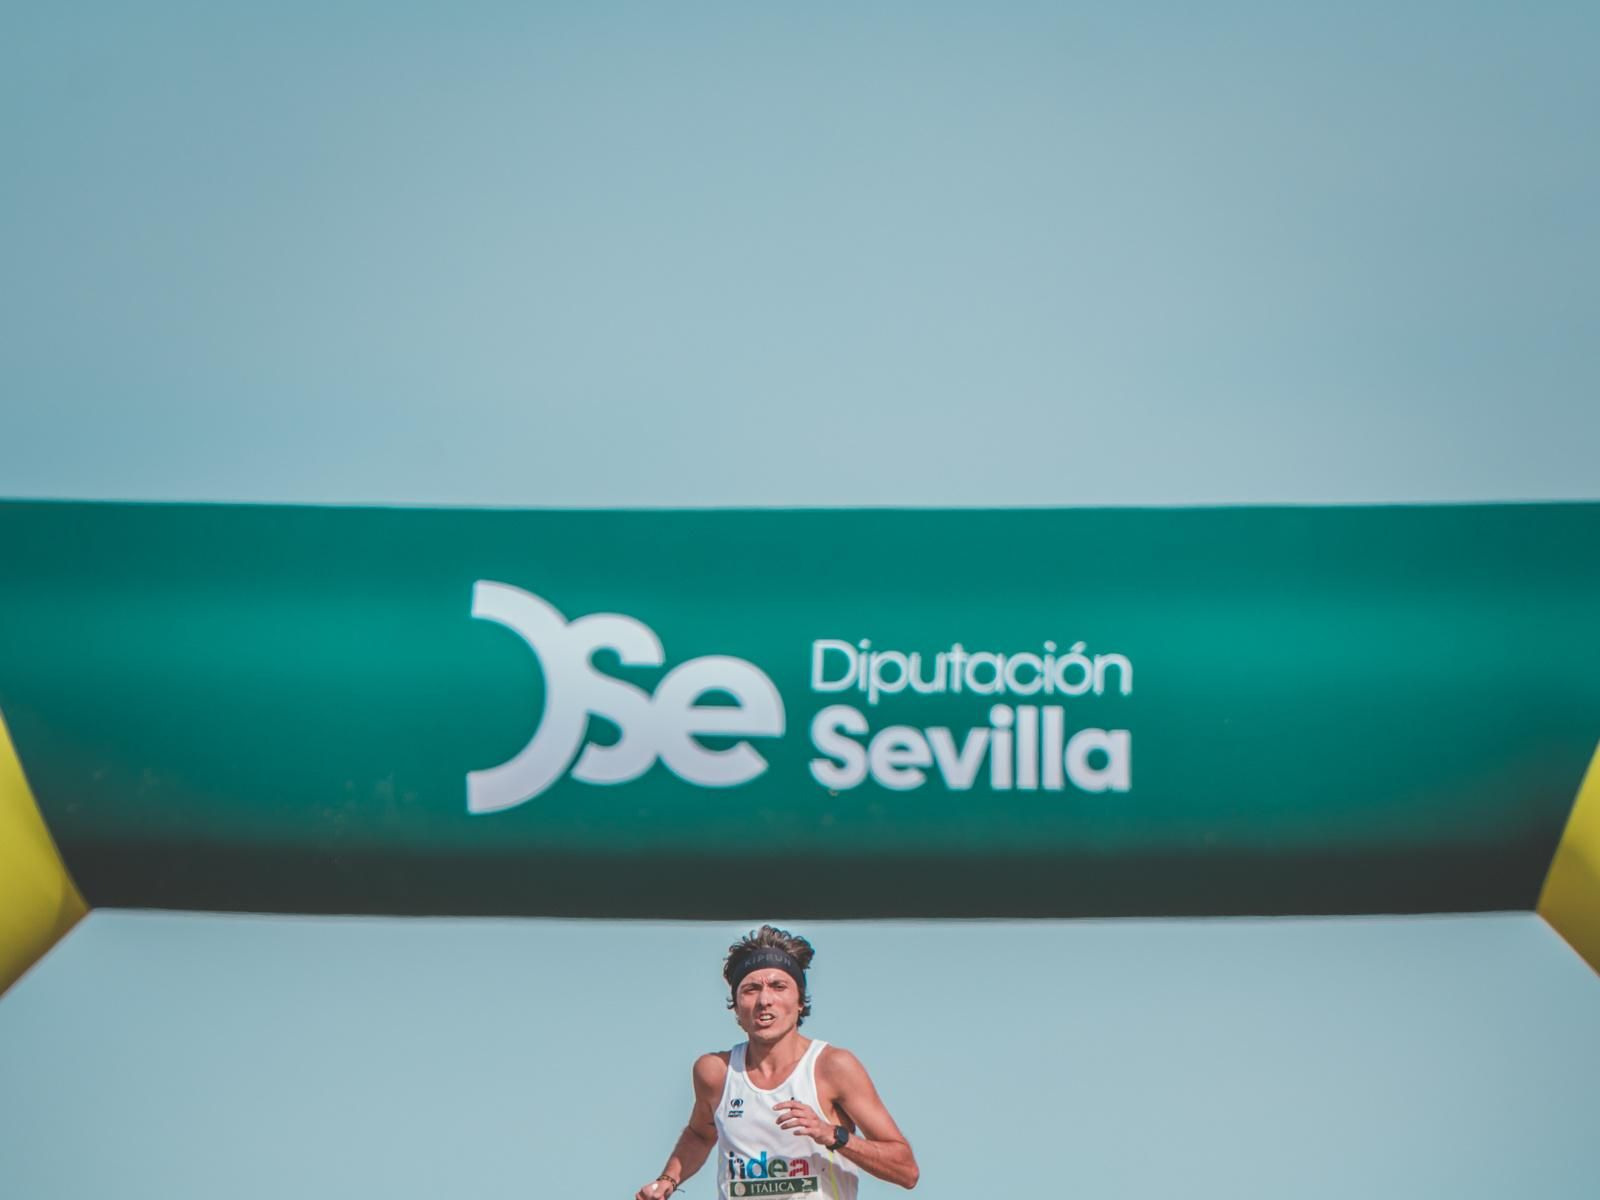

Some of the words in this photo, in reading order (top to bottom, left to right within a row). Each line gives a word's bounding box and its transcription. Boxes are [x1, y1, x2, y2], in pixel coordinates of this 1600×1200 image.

[810, 639, 1132, 704] Diputación
[809, 704, 1131, 793] Sevilla
[751, 1181, 796, 1194] ITÁLICA
